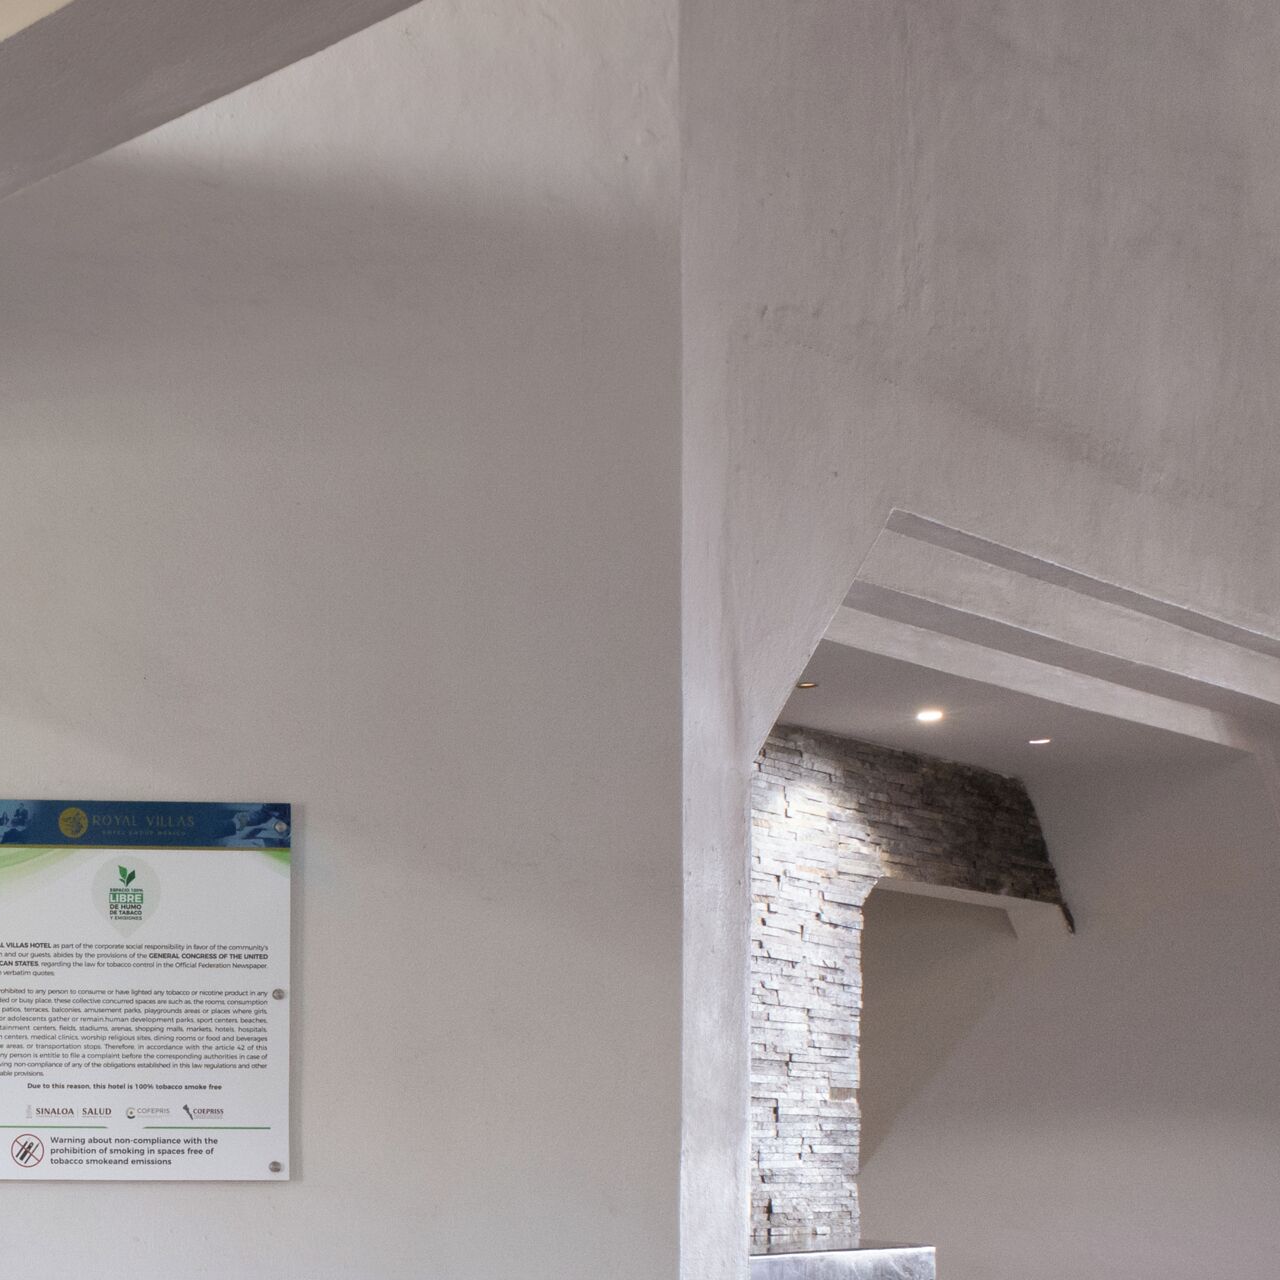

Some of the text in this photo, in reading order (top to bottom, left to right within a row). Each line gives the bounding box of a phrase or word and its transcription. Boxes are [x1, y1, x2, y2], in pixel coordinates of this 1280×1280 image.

[92, 815, 195, 828] ROYAL VILLAS
[110, 894, 142, 903] LIBRE
[42, 1082, 50, 1090] to
[51, 1082, 64, 1090] this
[92, 1082, 106, 1090] this
[107, 1082, 125, 1090] hotel
[127, 1082, 133, 1090] is
[135, 1082, 154, 1090] 100%
[155, 1082, 183, 1090] tobacco
[36, 1107, 112, 1115] SINALOA SALUD
[50, 1135, 218, 1147] Warning about non-compliance with the
[50, 1146, 214, 1157] prohibition of smoking in spaces free of
[50, 1156, 172, 1165] tobacco smokeand emissions
